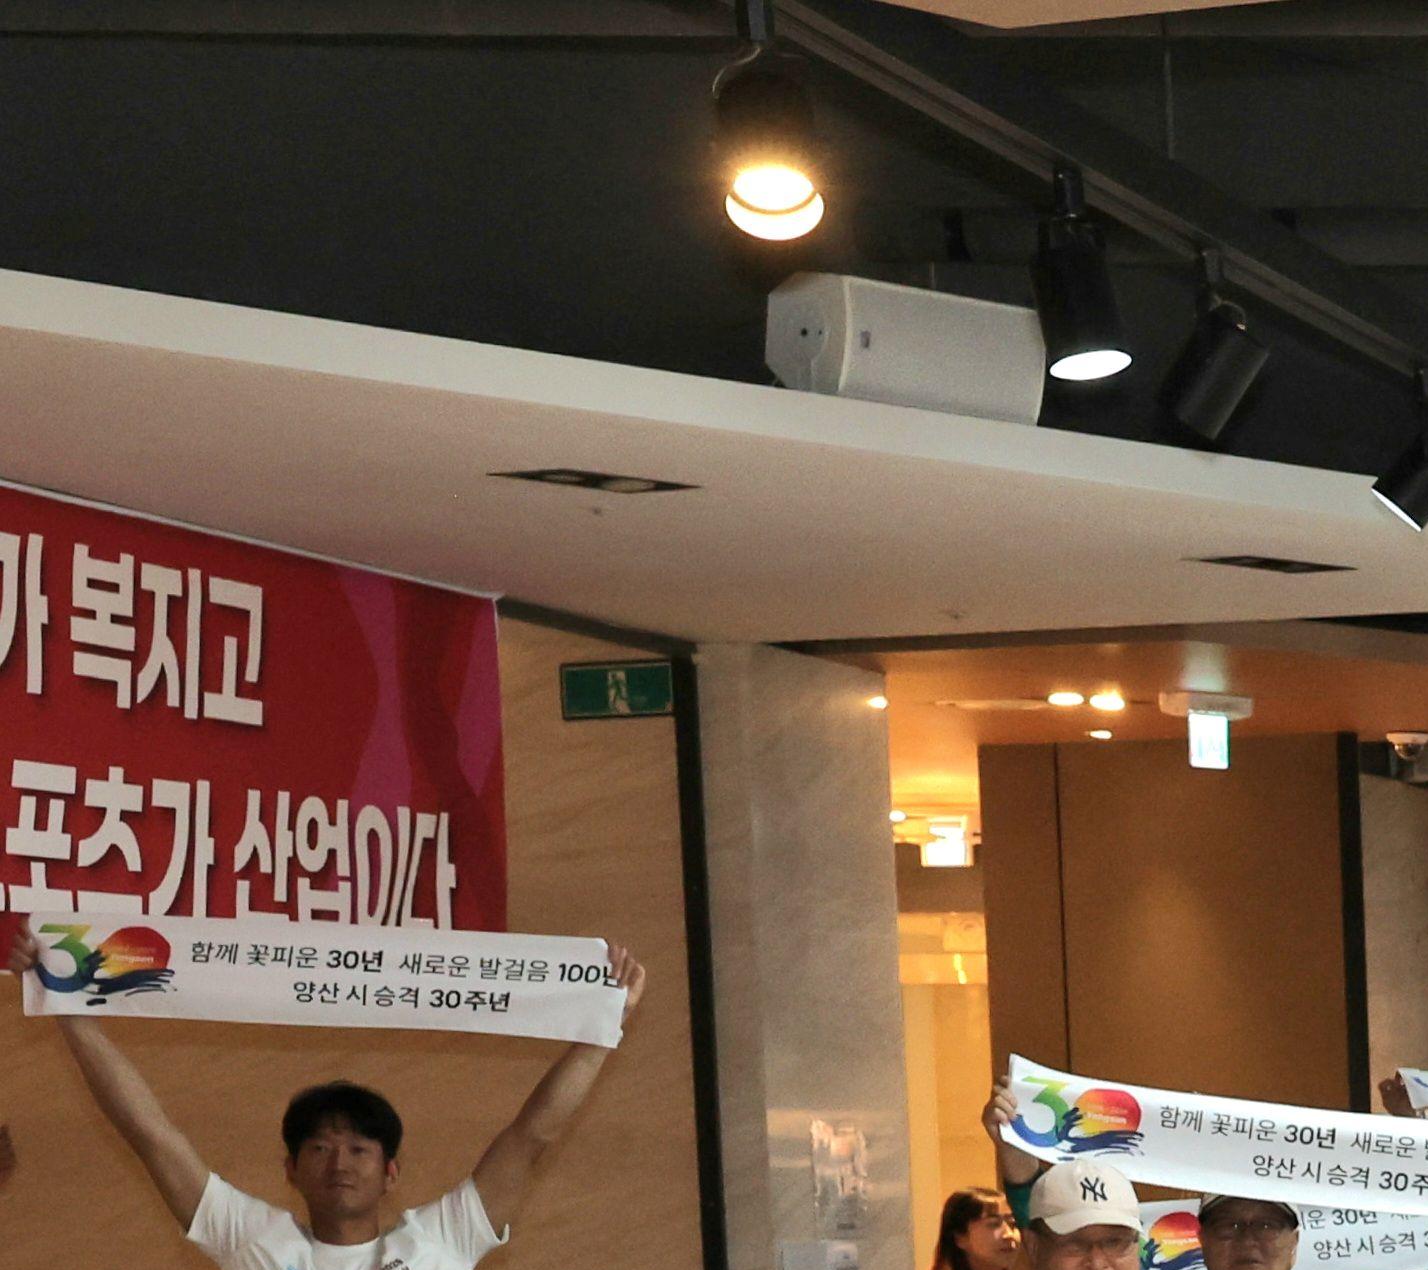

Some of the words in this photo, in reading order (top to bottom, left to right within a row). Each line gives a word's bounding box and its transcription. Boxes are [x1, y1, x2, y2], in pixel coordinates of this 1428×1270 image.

[70, 544, 263, 726] 복지고
[192, 941, 238, 964] 함께
[248, 944, 318, 968] 꽃피운
[327, 950, 383, 972] 30년
[399, 953, 470, 977] 새로운
[480, 958, 549, 982] 발걸음
[1160, 1106, 1203, 1133] 함께
[1211, 1114, 1277, 1142] 꽃피운
[1284, 1125, 1336, 1150] 30년
[1350, 1133, 1416, 1159] 새로운
